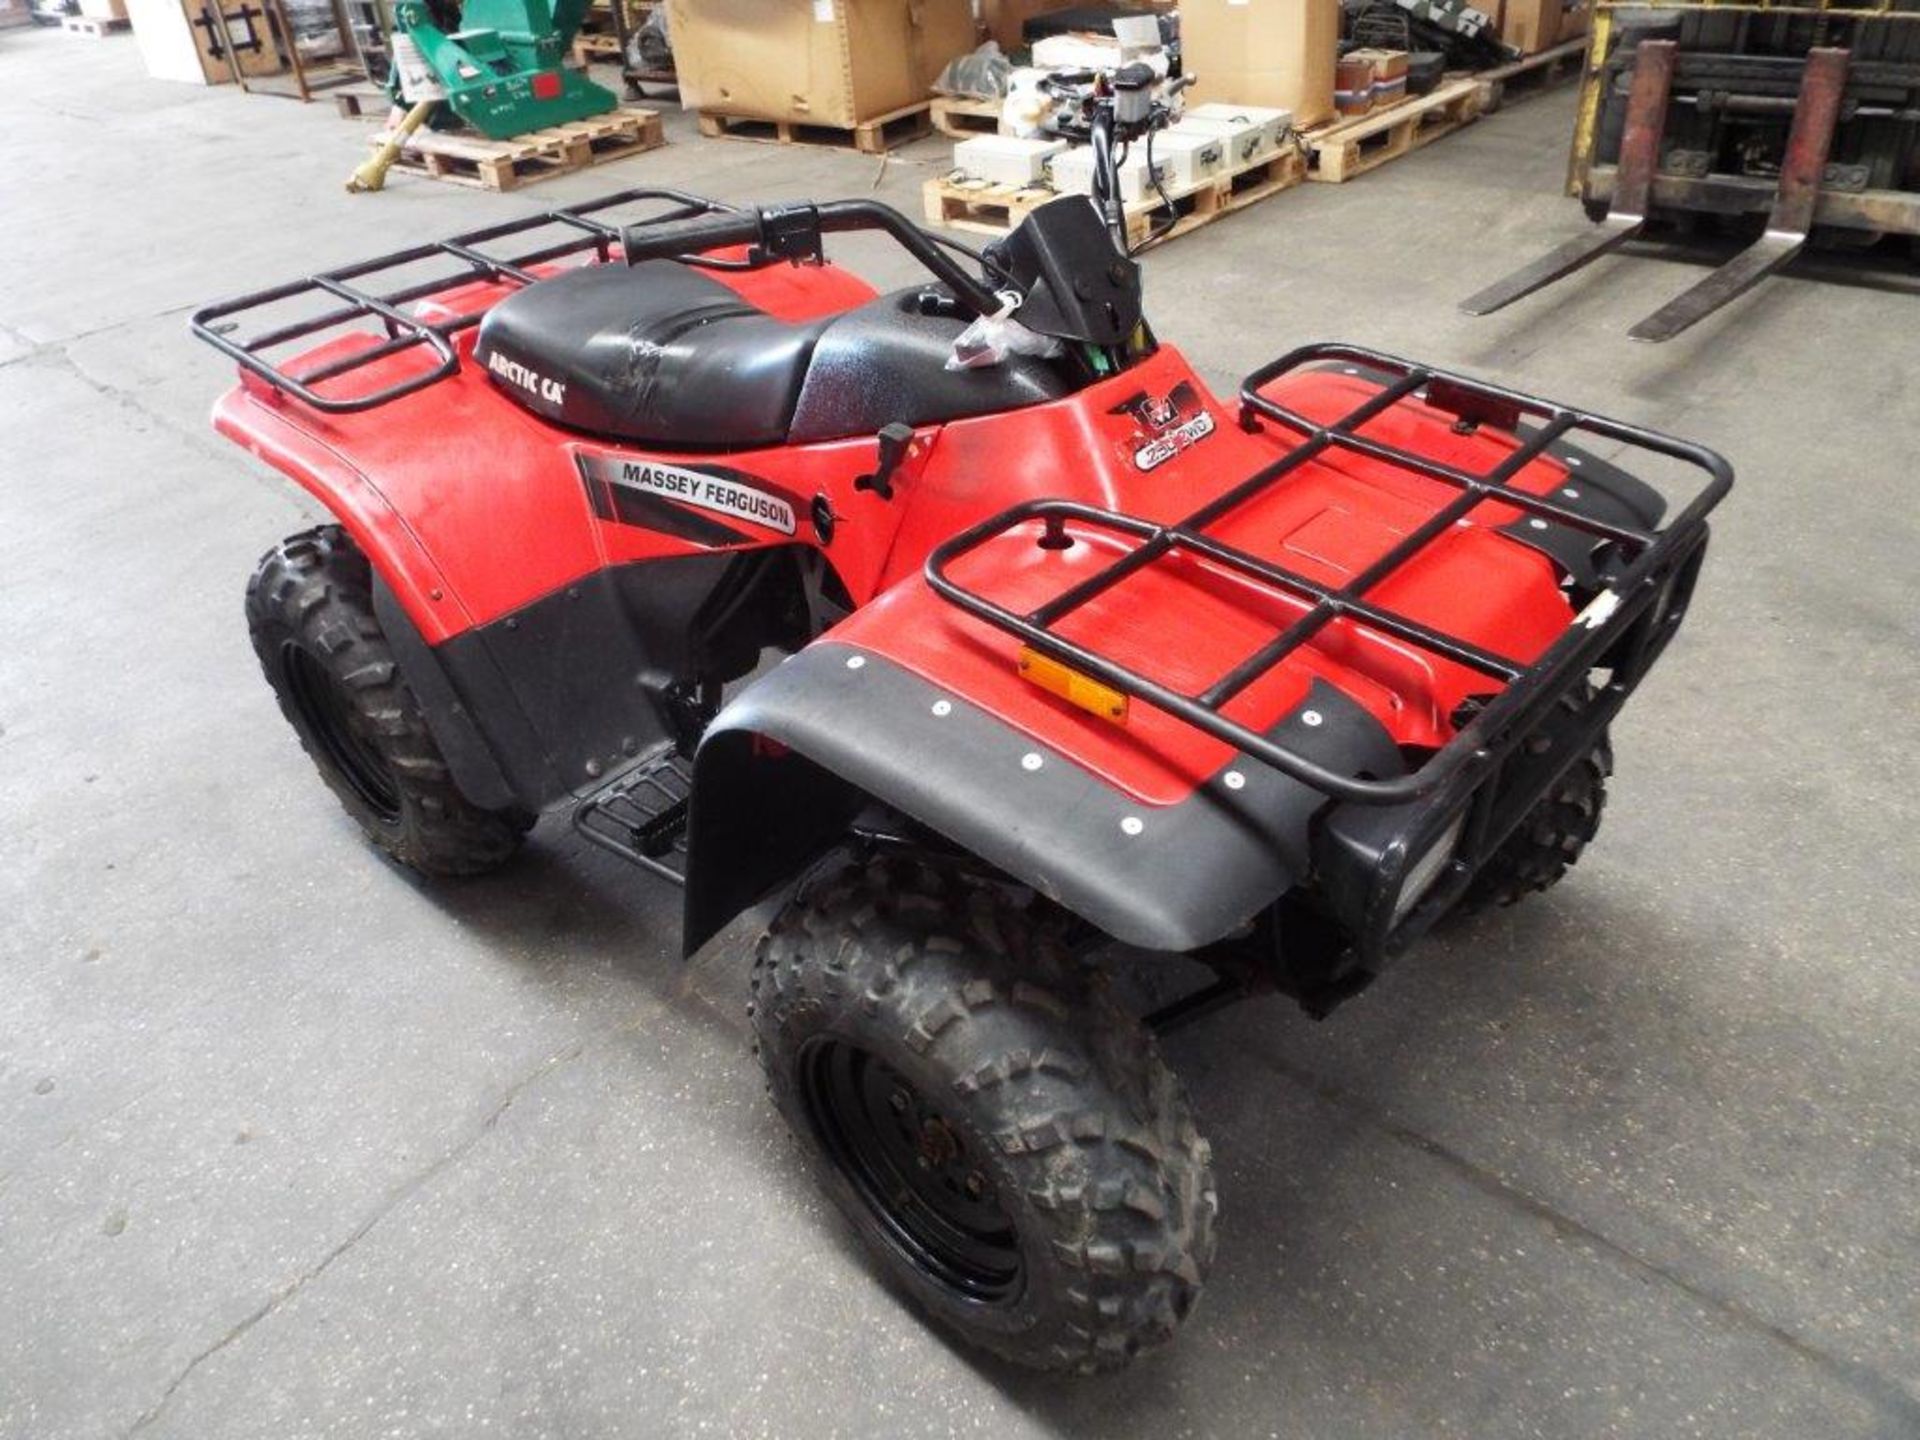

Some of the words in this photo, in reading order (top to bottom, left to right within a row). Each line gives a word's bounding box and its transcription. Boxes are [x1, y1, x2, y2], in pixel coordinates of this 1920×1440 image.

[489, 351, 538, 394] ARCTIC
[541, 377, 565, 405] CA
[623, 463, 701, 496] MASSEY
[705, 484, 789, 526] FERGUSON
